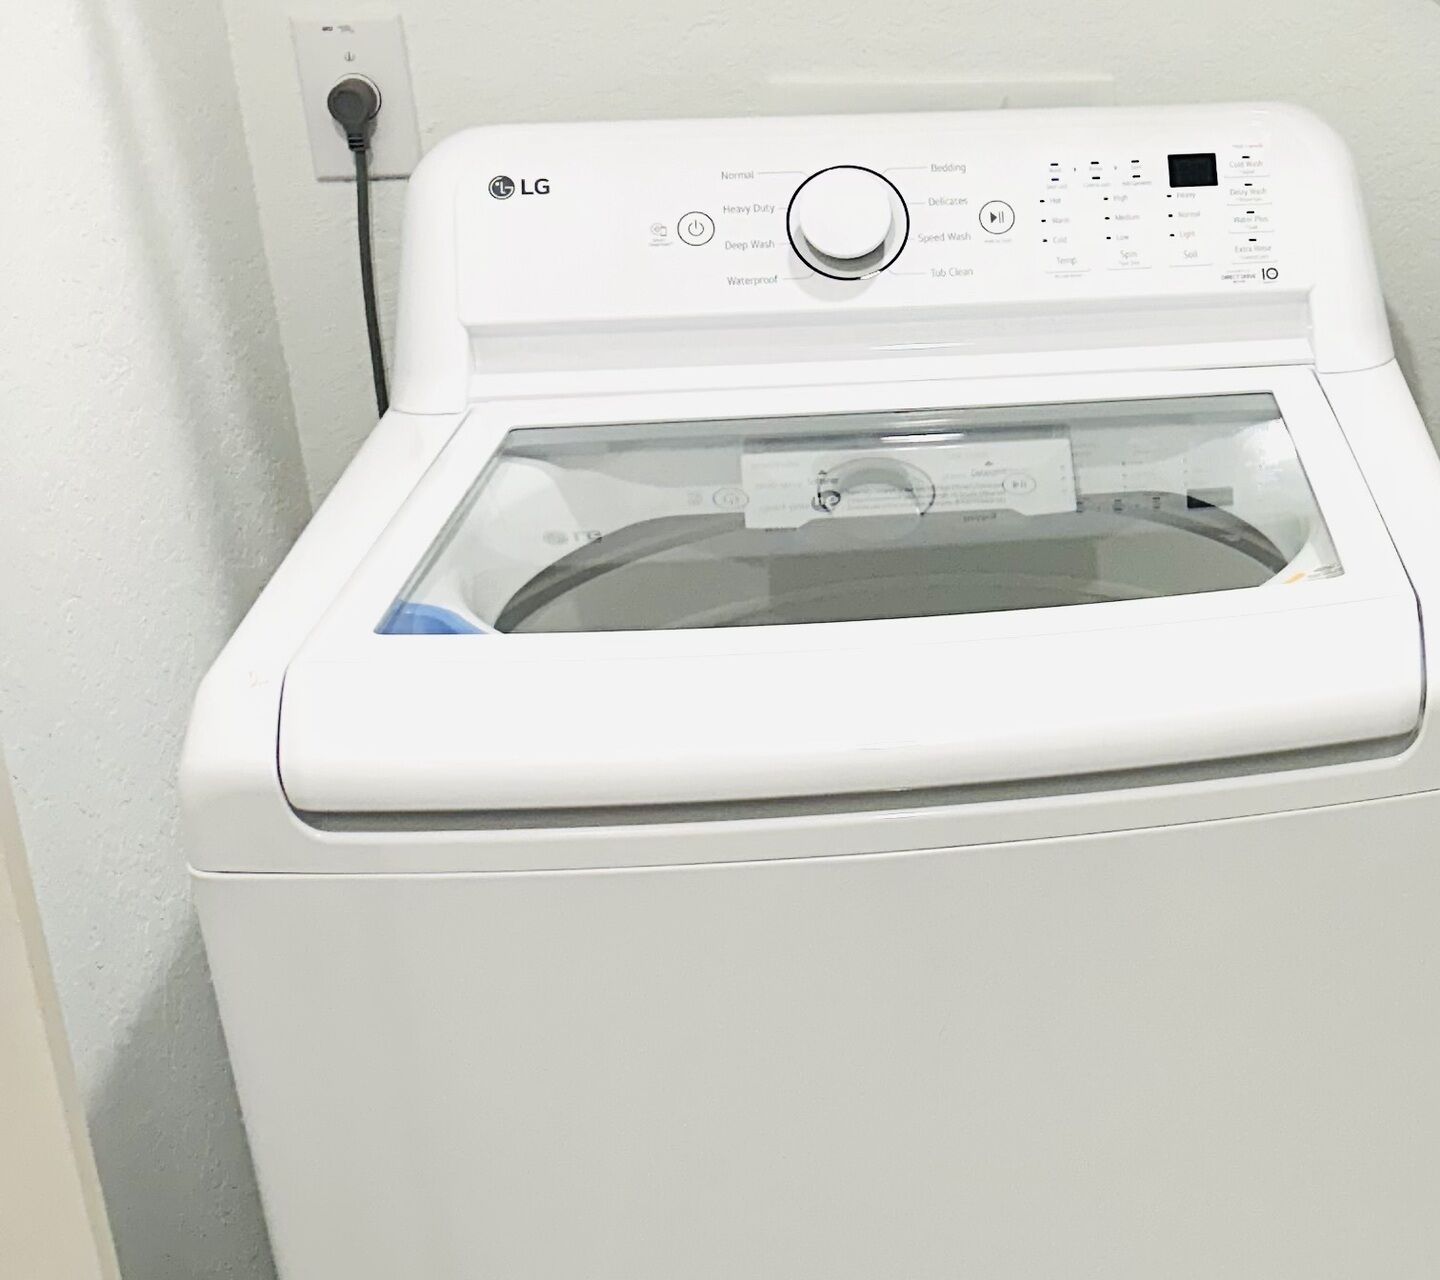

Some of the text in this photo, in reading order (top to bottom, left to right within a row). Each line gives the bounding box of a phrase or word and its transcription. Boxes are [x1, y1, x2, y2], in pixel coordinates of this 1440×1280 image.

[930, 163, 967, 174] Bedding
[721, 170, 754, 180] Normal
[521, 178, 550, 195] LG
[928, 197, 968, 207] Delicates
[723, 203, 776, 216] Heavy Duty
[918, 232, 946, 244] Speed
[948, 231, 972, 241] Wash
[725, 239, 775, 251] Deep Wash
[931, 267, 974, 278] Tub Clean
[727, 274, 778, 287] Waterproof
